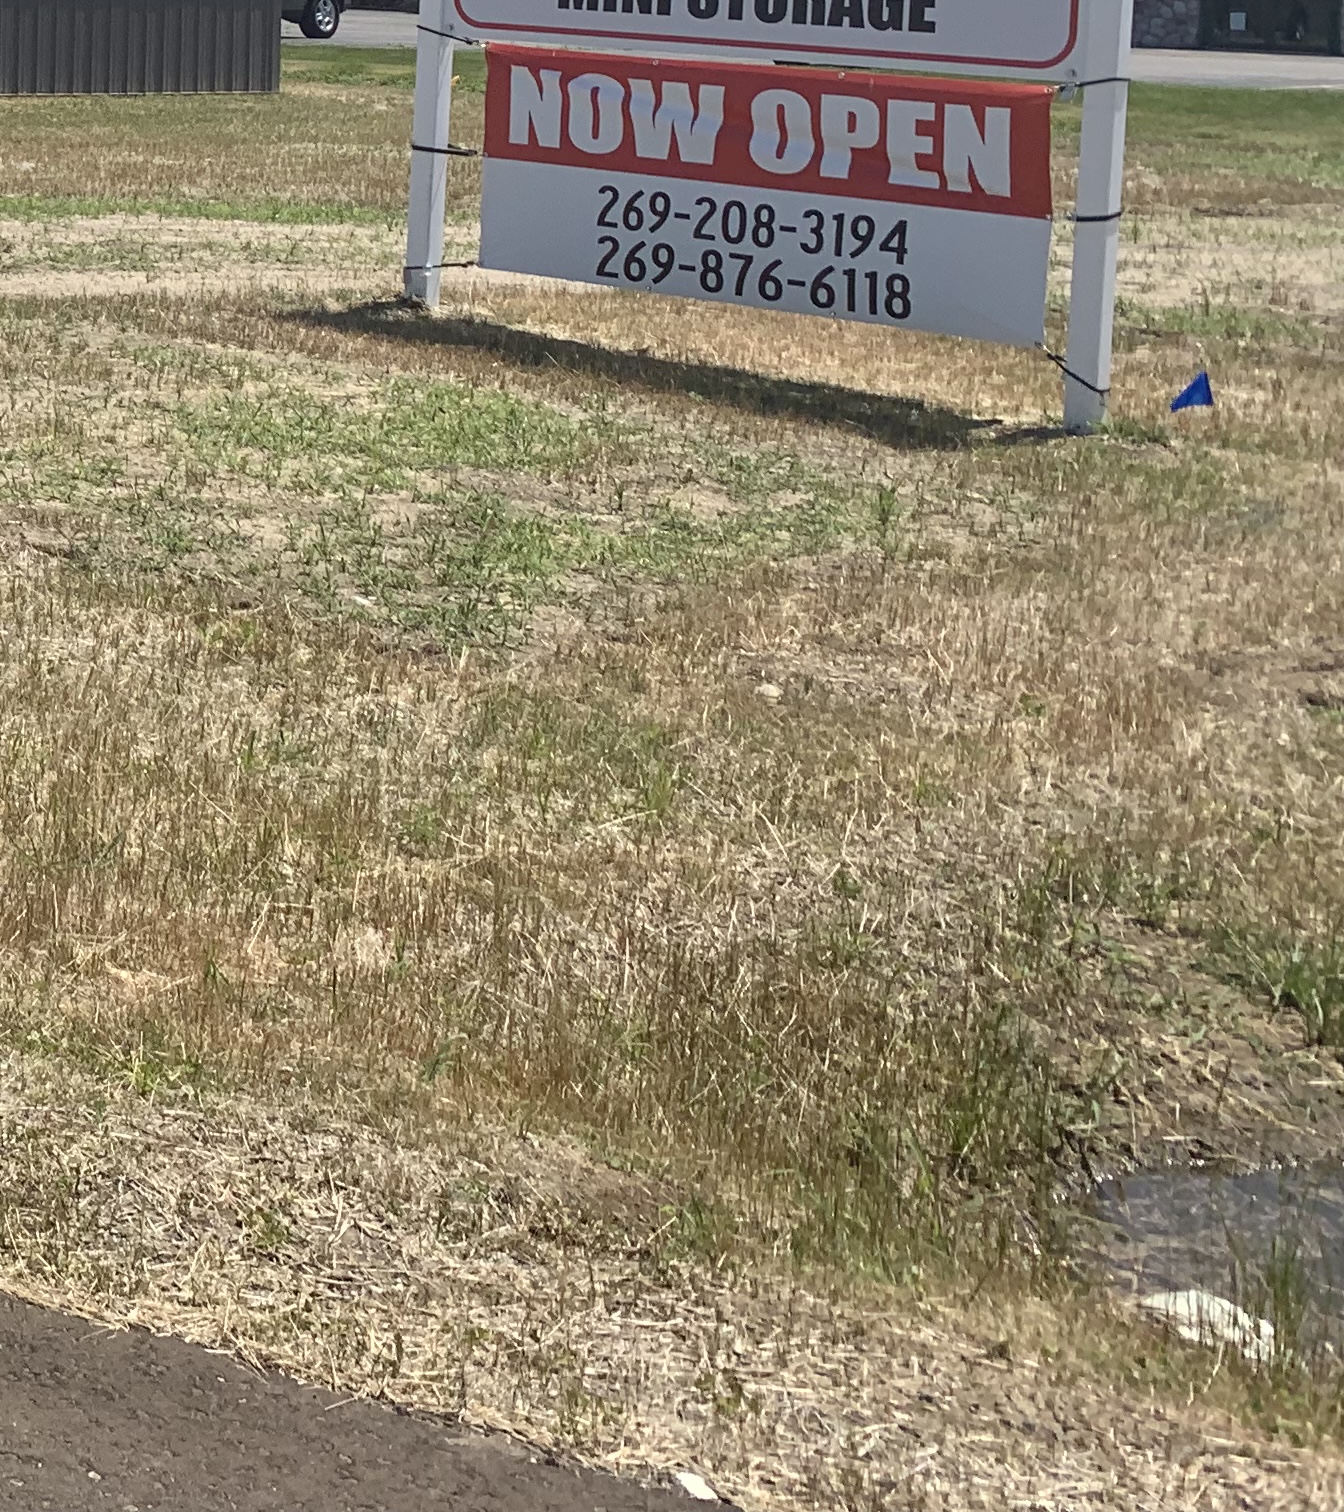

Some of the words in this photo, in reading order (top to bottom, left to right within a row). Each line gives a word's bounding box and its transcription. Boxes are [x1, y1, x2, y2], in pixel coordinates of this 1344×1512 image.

[507, 66, 725, 165] NOW
[750, 89, 1011, 198] OPEN
[597, 184, 909, 265] 269-208-3194
[596, 236, 912, 319] 269-876-6118
